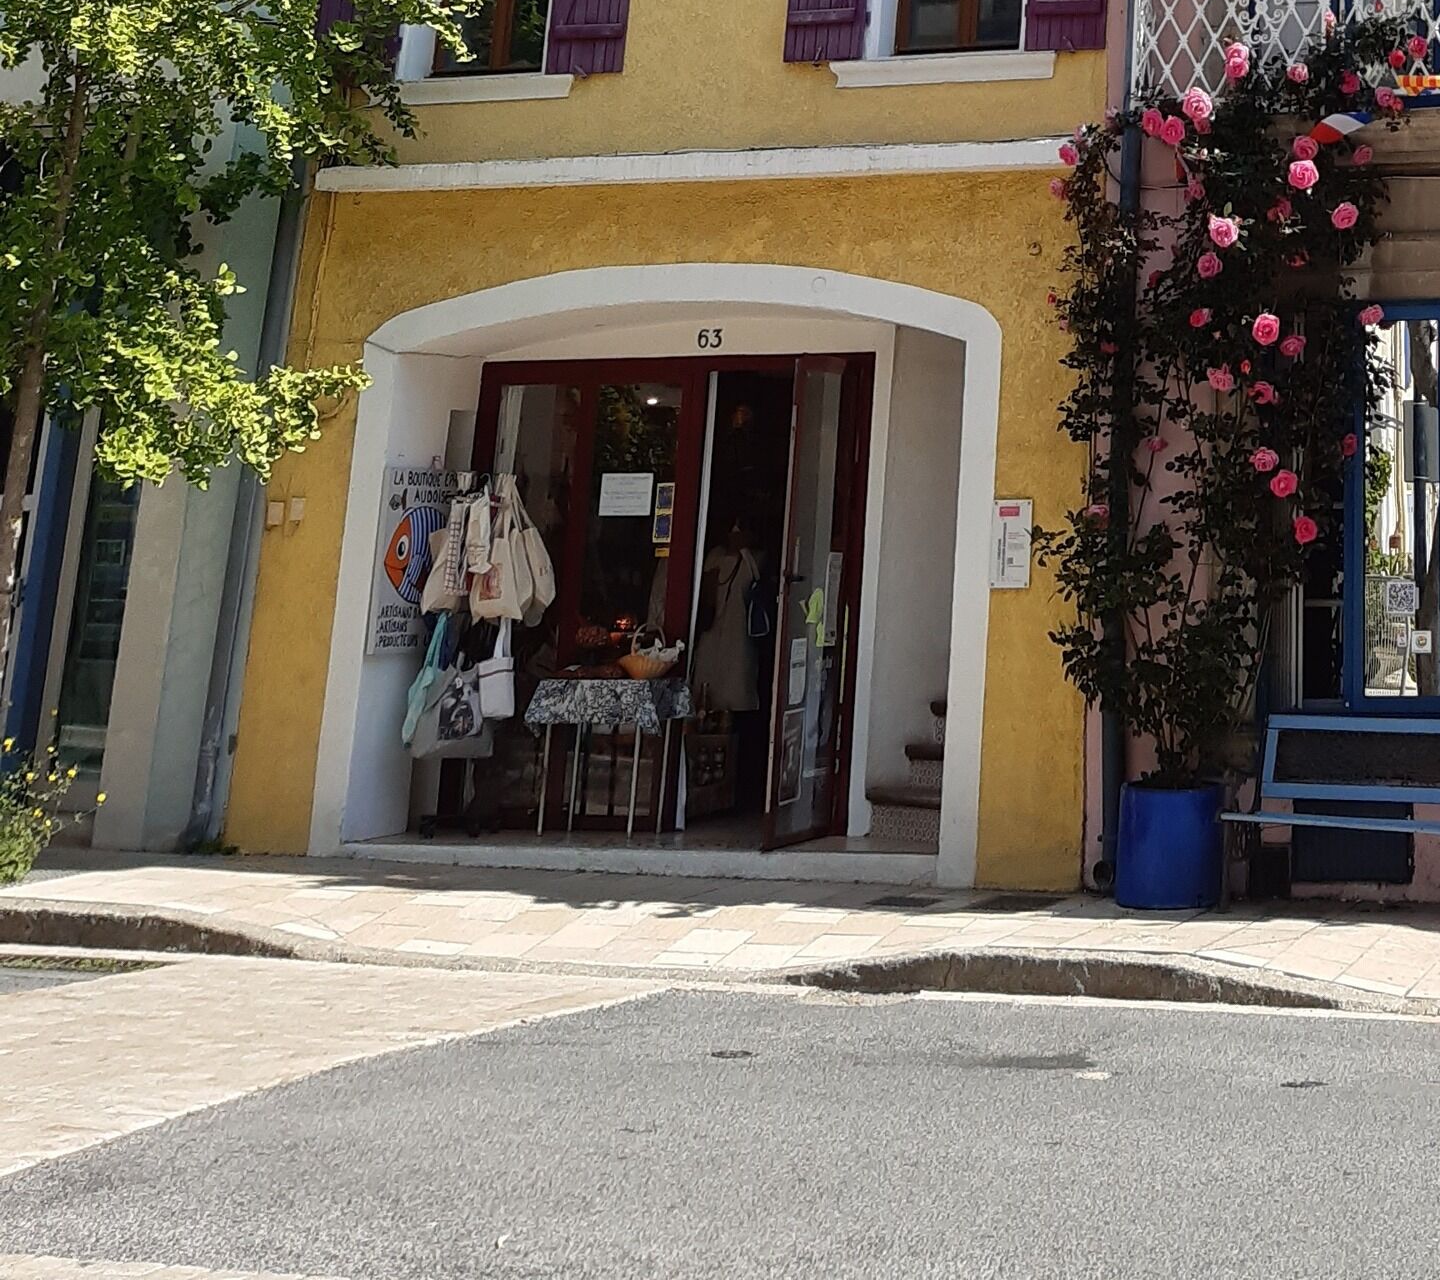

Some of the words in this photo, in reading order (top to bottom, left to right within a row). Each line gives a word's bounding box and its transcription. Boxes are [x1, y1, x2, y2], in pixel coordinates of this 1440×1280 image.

[697, 328, 723, 349] 63
[393, 471, 404, 486] LA
[407, 471, 441, 487] BOUTIQUE
